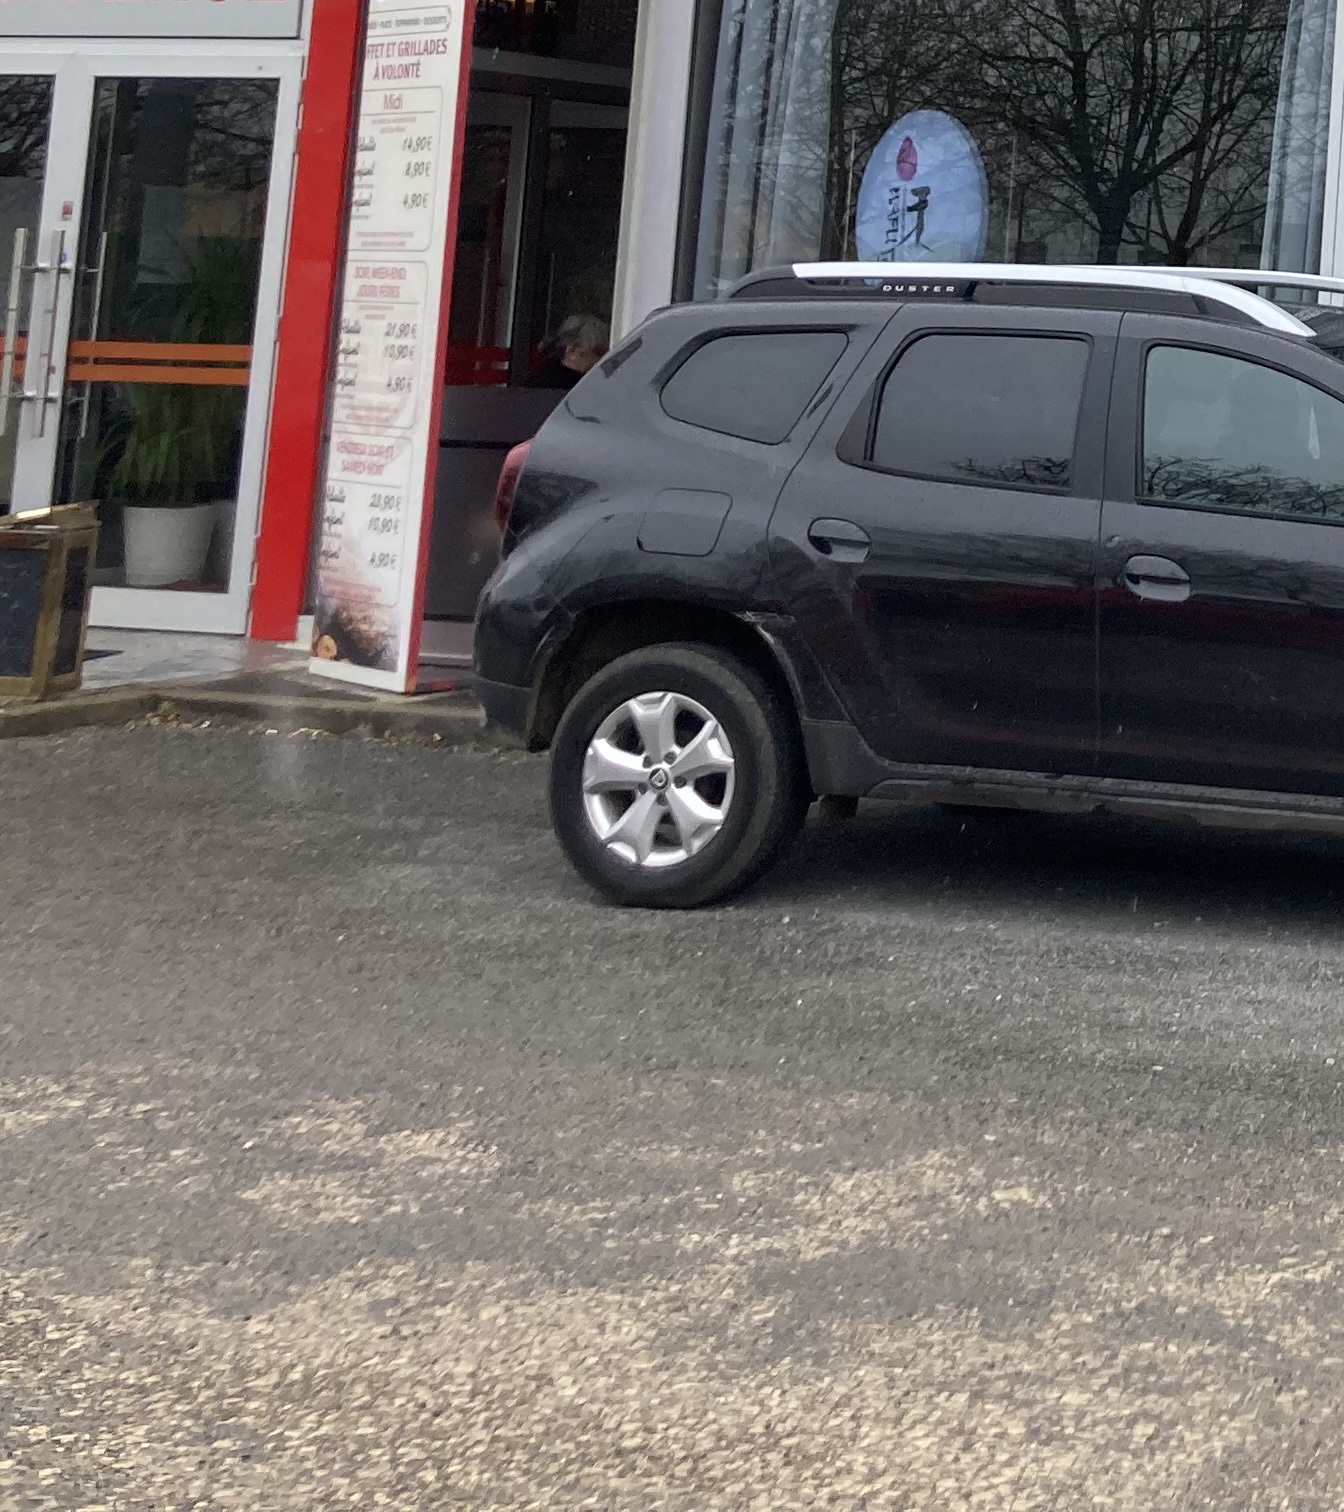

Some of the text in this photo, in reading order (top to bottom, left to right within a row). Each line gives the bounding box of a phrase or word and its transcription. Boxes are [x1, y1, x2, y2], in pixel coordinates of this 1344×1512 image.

[386, 42, 397, 58] ET
[398, 38, 448, 57] GRILLADES
[381, 59, 421, 80] VOLONTÉ
[882, 284, 955, 293] DUSTER
